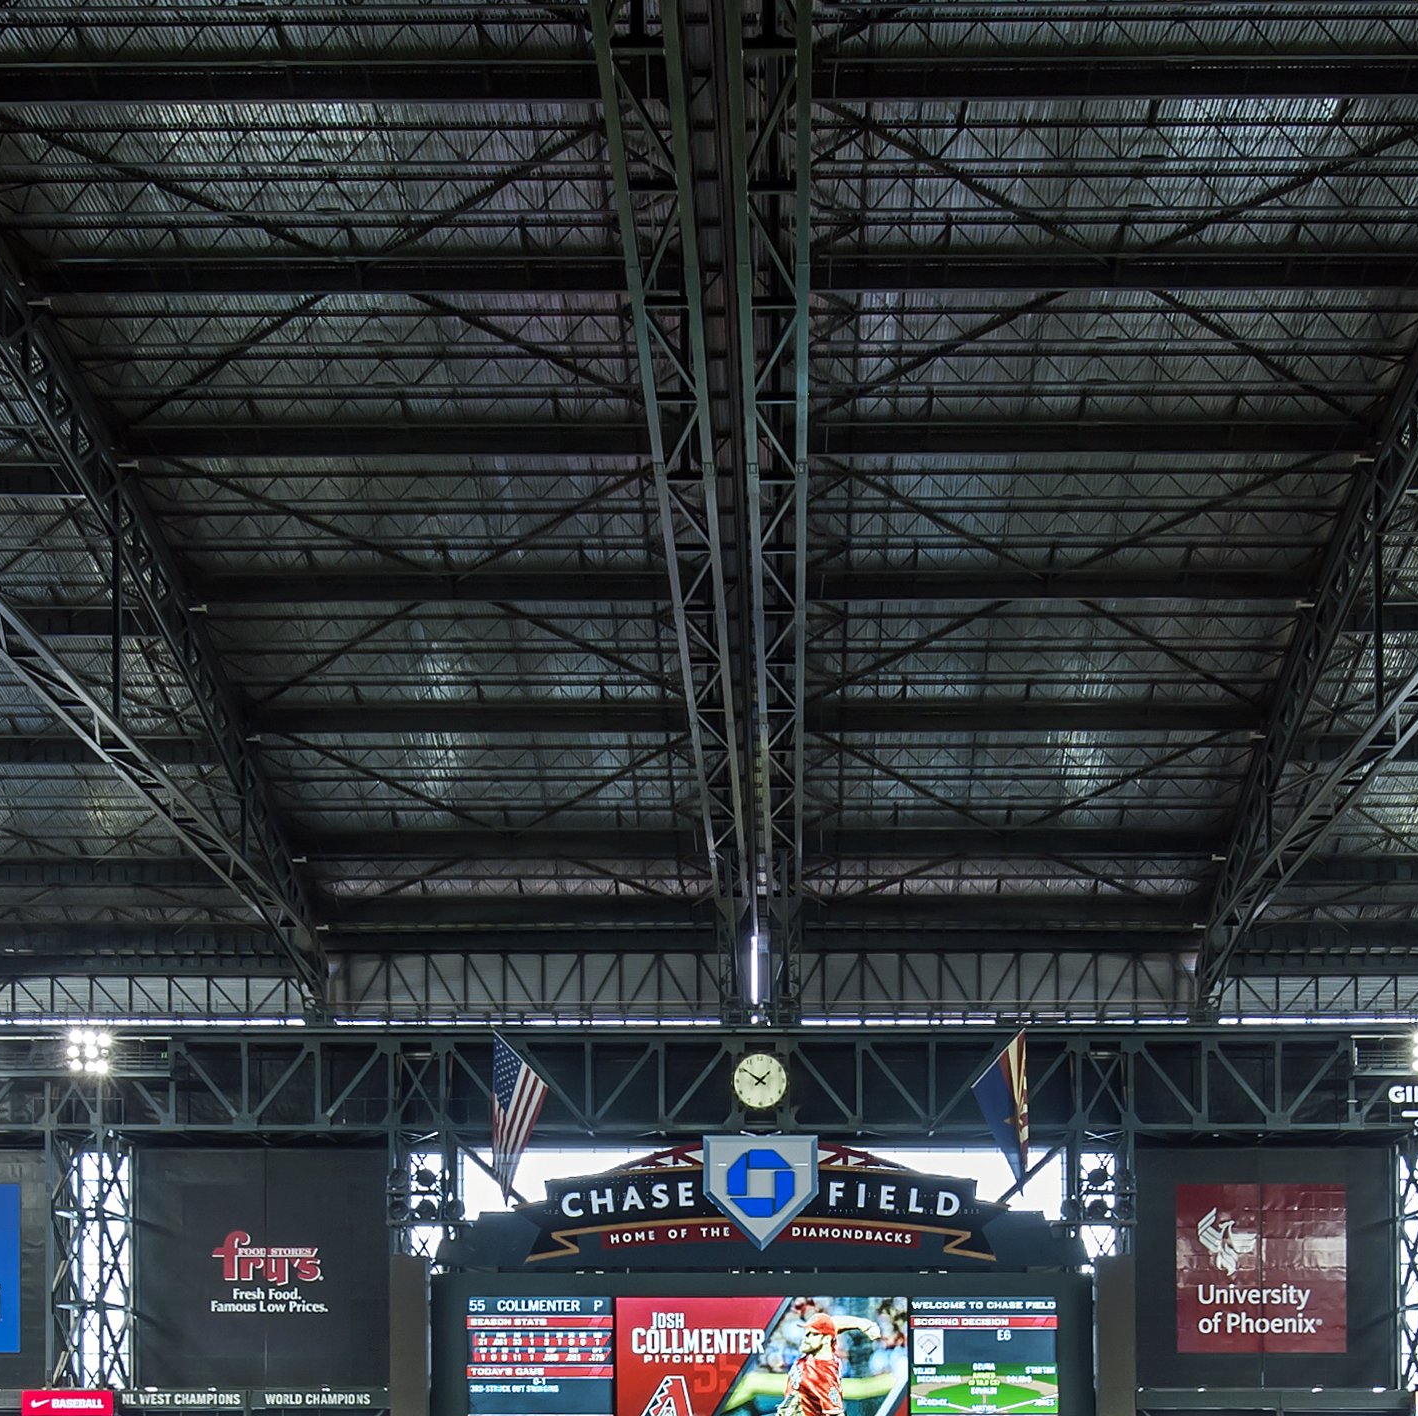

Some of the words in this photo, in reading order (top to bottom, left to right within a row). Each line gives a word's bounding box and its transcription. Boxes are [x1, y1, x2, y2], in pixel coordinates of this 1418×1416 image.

[561, 1181, 695, 1218] CHASE
[828, 1181, 960, 1217] FIELD
[610, 1230, 655, 1244] HOME
[668, 1228, 688, 1239] OF
[701, 1227, 730, 1238] THE
[791, 1227, 912, 1244] DIAMONDBACKS
[212, 1230, 323, 1286] fry's
[238, 1248, 266, 1257] FOOD
[271, 1248, 312, 1257] STORES
[233, 1288, 265, 1300] Fresh
[269, 1288, 301, 1300] Food.
[1197, 1285, 1310, 1310] University
[211, 1301, 256, 1312] Famous
[260, 1301, 286, 1312] Low
[289, 1301, 328, 1312] Prices.
[469, 1300, 485, 1312] 55
[497, 1300, 580, 1312] COLLMENTER
[912, 1301, 966, 1309] WELCOME
[970, 1301, 984, 1309] TO
[987, 1301, 1023, 1309] CHASE
[1025, 1301, 1056, 1309] FIELD
[651, 1312, 685, 1329] JOSH
[1198, 1313, 1221, 1333] of
[1226, 1313, 1315, 1334] Phoenix
[631, 1328, 766, 1355] COLLMENTER
[643, 1355, 716, 1364] PITCHER
[52, 1399, 104, 1408] BASEBALL
[122, 1394, 136, 1404] NL
[139, 1394, 171, 1404] WEST
[175, 1394, 240, 1404] CHAMPIONS
[265, 1394, 303, 1404] WORLD
[306, 1394, 371, 1404] CHAMPIONS
